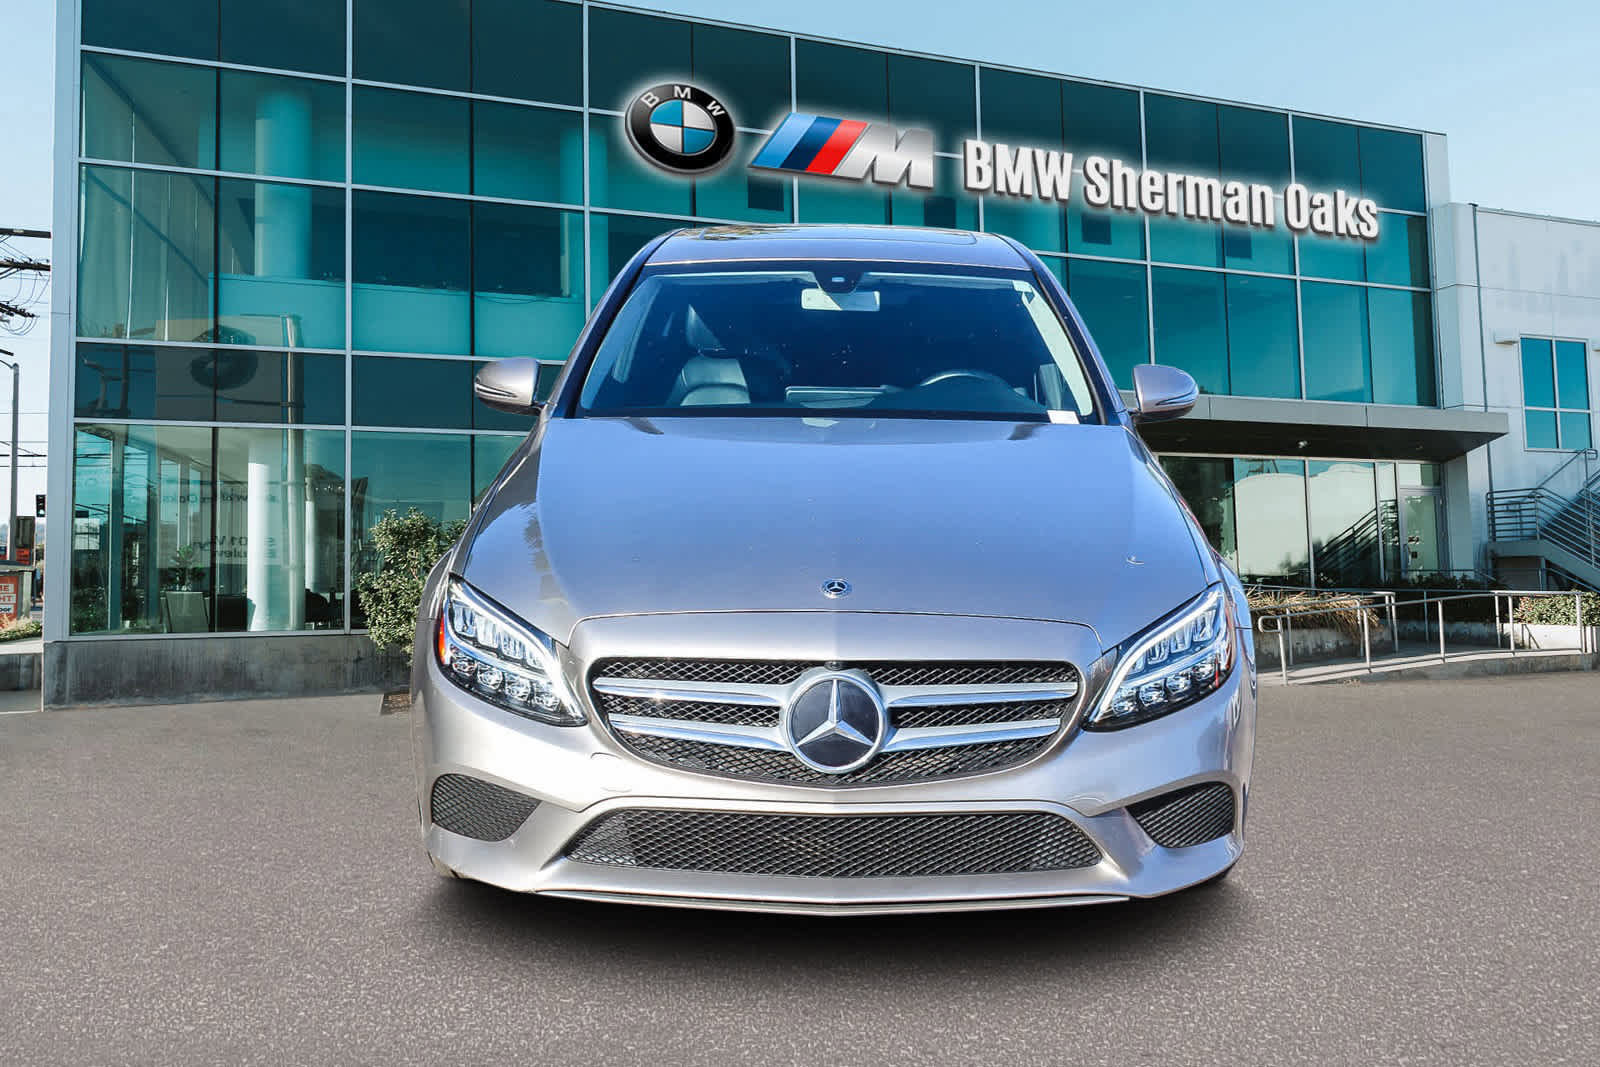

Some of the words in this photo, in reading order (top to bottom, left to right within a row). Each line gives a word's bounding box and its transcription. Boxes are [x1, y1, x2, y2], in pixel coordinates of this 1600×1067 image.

[640, 85, 725, 117] BMW
[834, 123, 935, 188] M
[963, 139, 1073, 201] BMW
[1083, 156, 1275, 228] Sherman
[1284, 183, 1379, 239] Oaks
